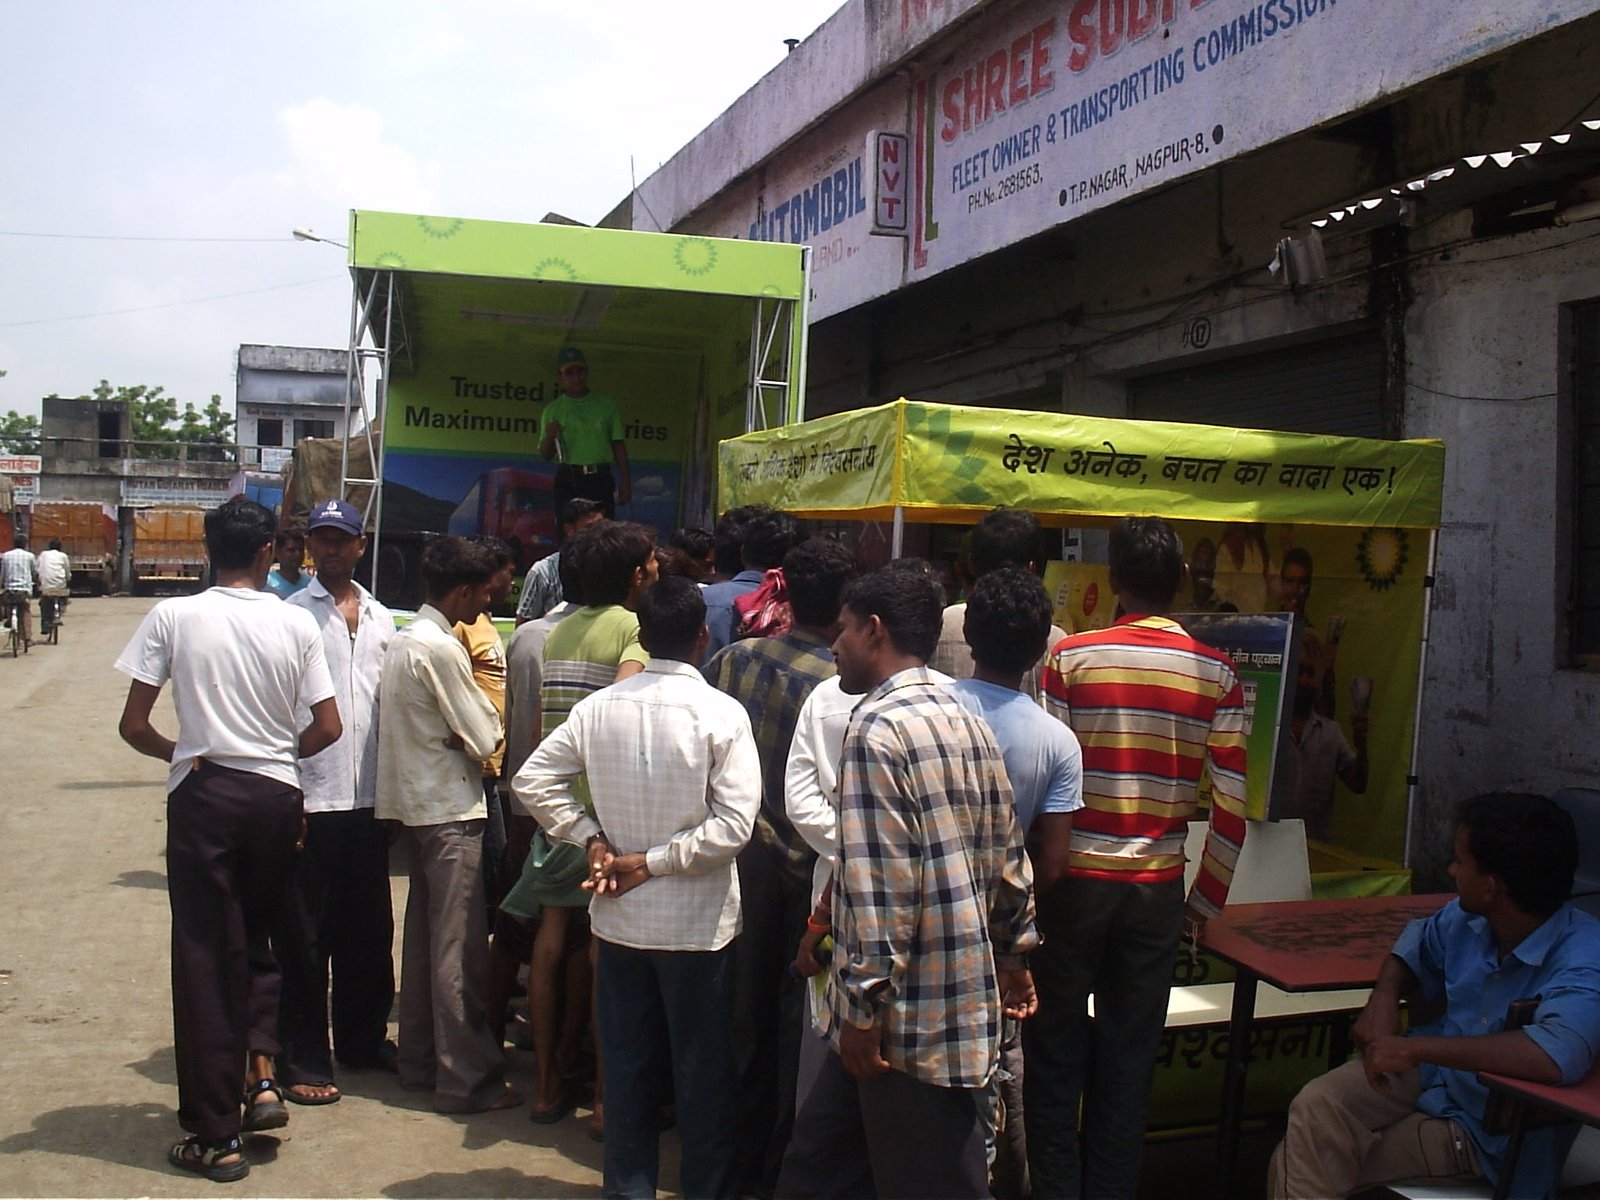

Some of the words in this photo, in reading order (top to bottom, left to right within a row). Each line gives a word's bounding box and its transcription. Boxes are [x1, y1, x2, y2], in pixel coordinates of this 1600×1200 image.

[941, 18, 1056, 143] SHREE
[952, 149, 989, 194] FLEET
[992, 124, 1041, 173] OWNER
[1046, 113, 1057, 144] &
[1060, 47, 1185, 140] TRANSPORTING
[1193, 0, 1337, 72] COMMISSIO
[749, 156, 866, 244] UTOMOBIL
[883, 139, 902, 221] NVT
[404, 405, 538, 433] Maximum
[450, 375, 544, 401] Trusted
[1002, 433, 1055, 474] देश
[1063, 440, 1148, 484] अनेक,
[1161, 455, 1228, 484] बचत
[1233, 461, 1271, 486] का
[1278, 464, 1335, 491] वादा
[1251, 652, 1283, 668] पहचान
